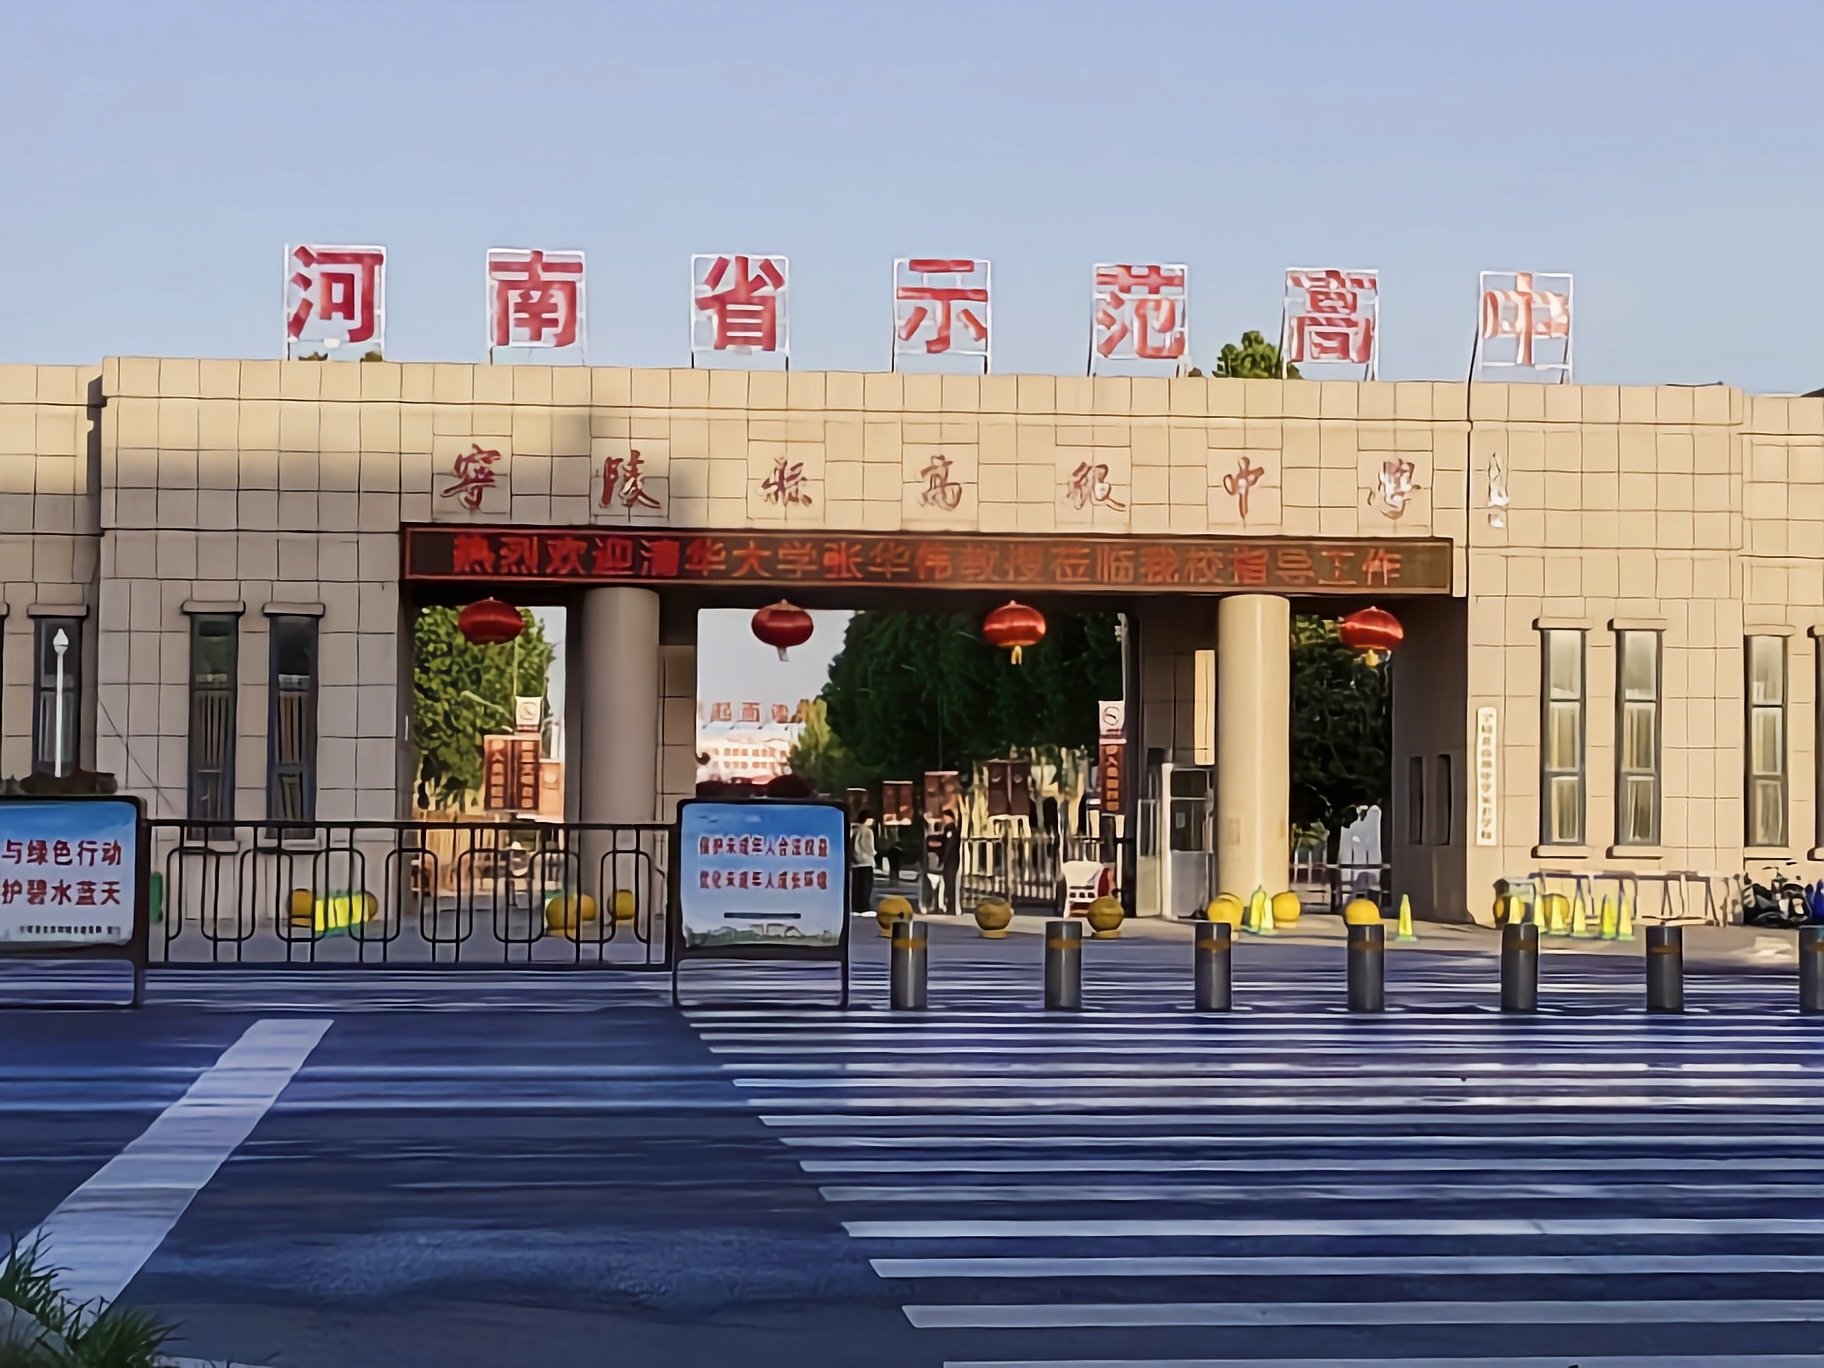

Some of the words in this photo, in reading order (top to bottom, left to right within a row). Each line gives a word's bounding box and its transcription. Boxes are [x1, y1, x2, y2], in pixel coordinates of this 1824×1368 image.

[287, 245, 1570, 366] 河南省示范高中
[452, 533, 1403, 587] 热烈欢迎清华大学张华伟教授莅临我校指导工作
[2, 839, 122, 867] 与绿色行动
[1, 878, 121, 906] 护碧水蓝天
